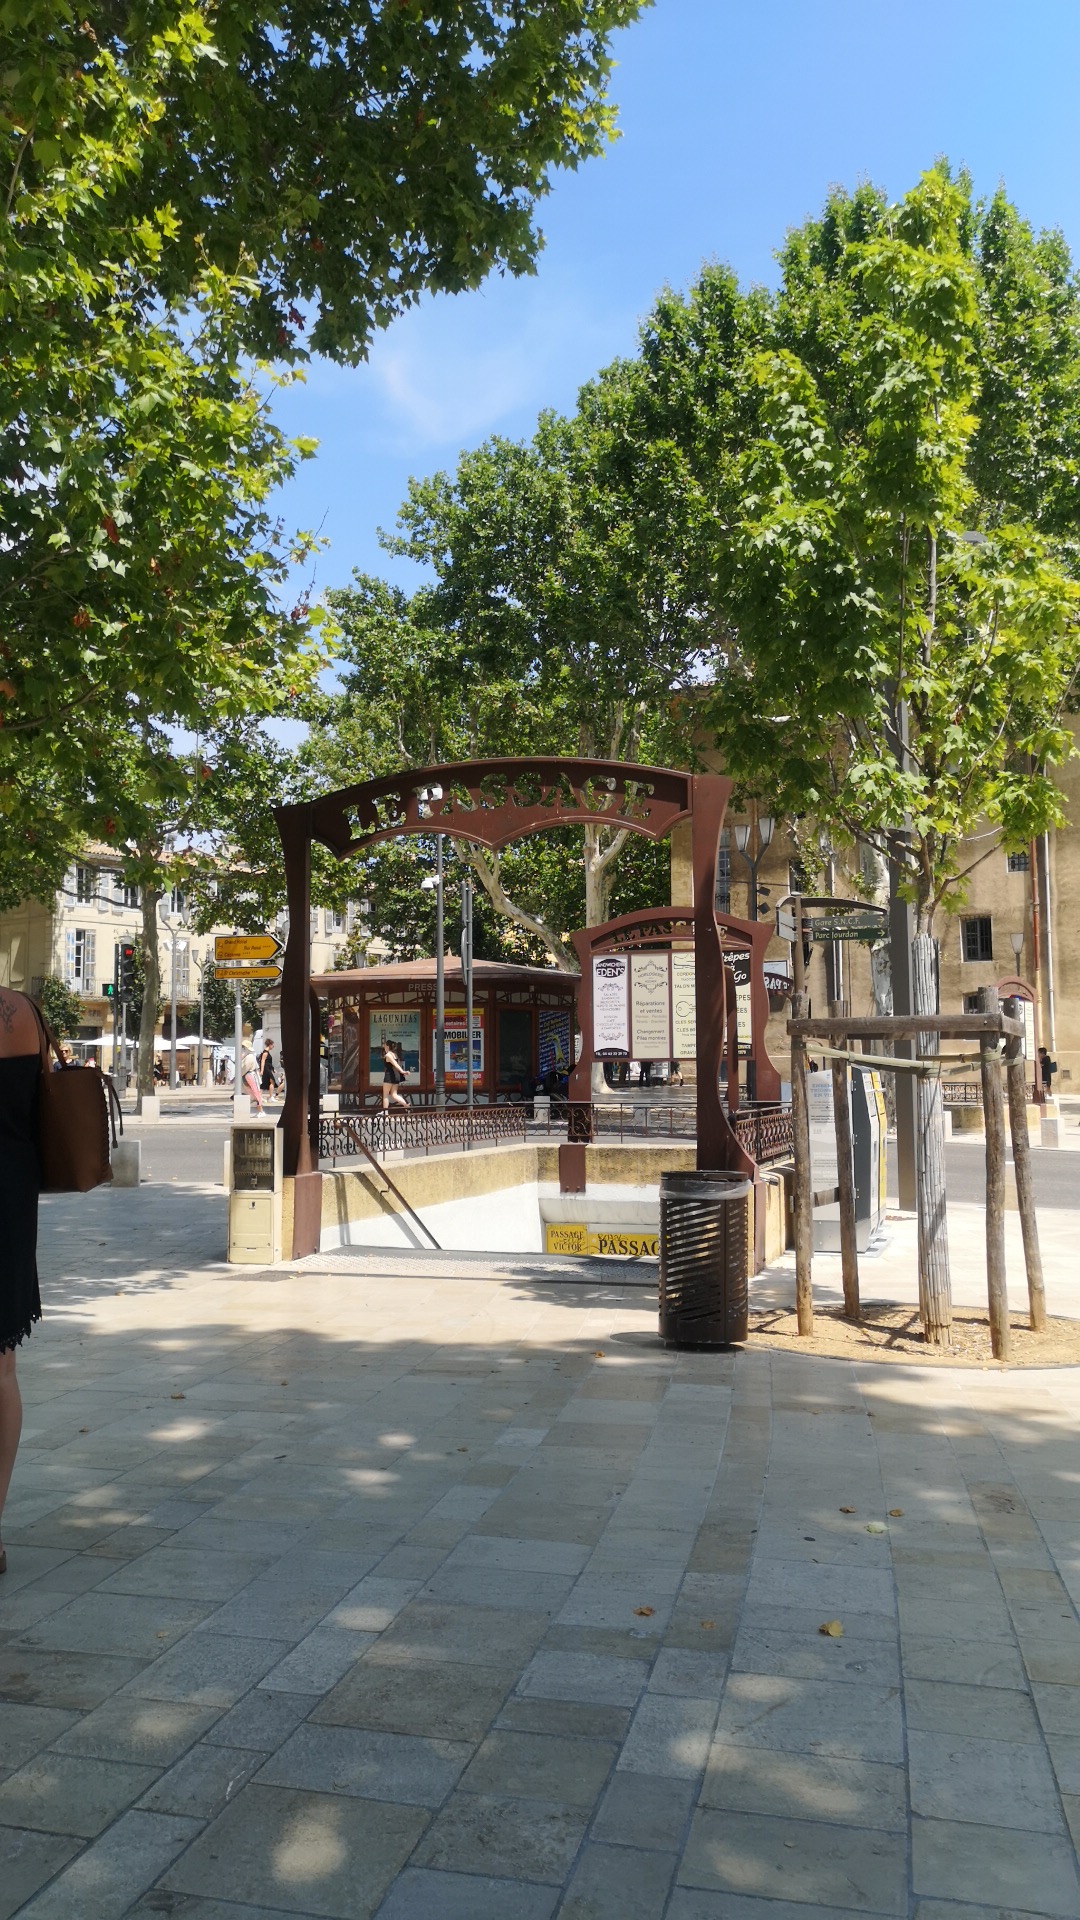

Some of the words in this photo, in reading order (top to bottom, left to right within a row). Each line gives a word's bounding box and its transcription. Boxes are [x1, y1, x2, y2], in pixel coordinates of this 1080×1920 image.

[343, 793, 406, 841] LE
[416, 772, 654, 819] PASSAGE
[833, 918, 861, 926] S.N.C.F.
[831, 931, 858, 940] Jourdan
[596, 967, 626, 977] EDEN'S
[734, 971, 747, 983] Go
[373, 1014, 418, 1024] LAGUNITAS
[434, 1031, 481, 1039] IMOBILER
[550, 1230, 584, 1240] PASSAGE
[553, 1243, 582, 1251] VICTOR
